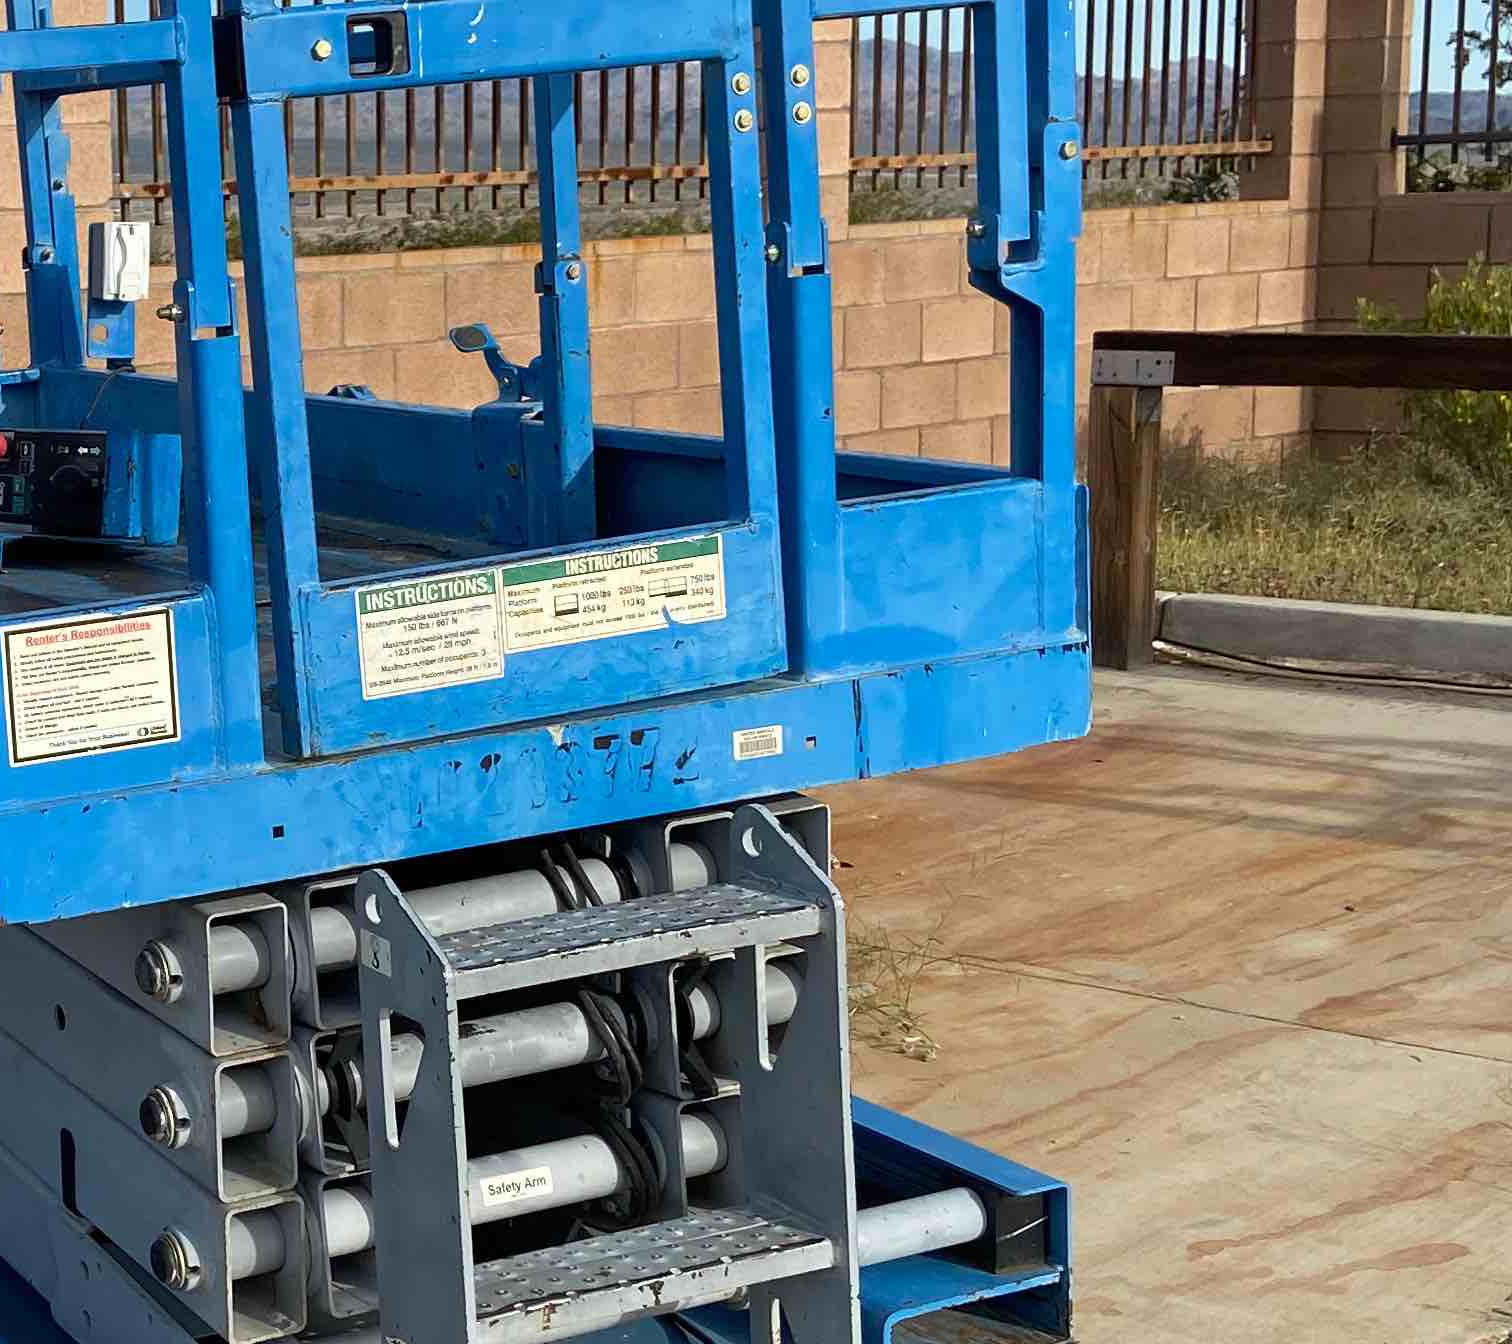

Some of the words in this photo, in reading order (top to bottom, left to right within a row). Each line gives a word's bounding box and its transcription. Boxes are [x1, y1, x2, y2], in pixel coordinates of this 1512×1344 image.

[565, 545, 659, 576] INSTRUCTIONS
[366, 576, 488, 611] INSTRUCTIONS
[488, 1181, 521, 1196] Safety
[524, 1176, 547, 1189] Arm
